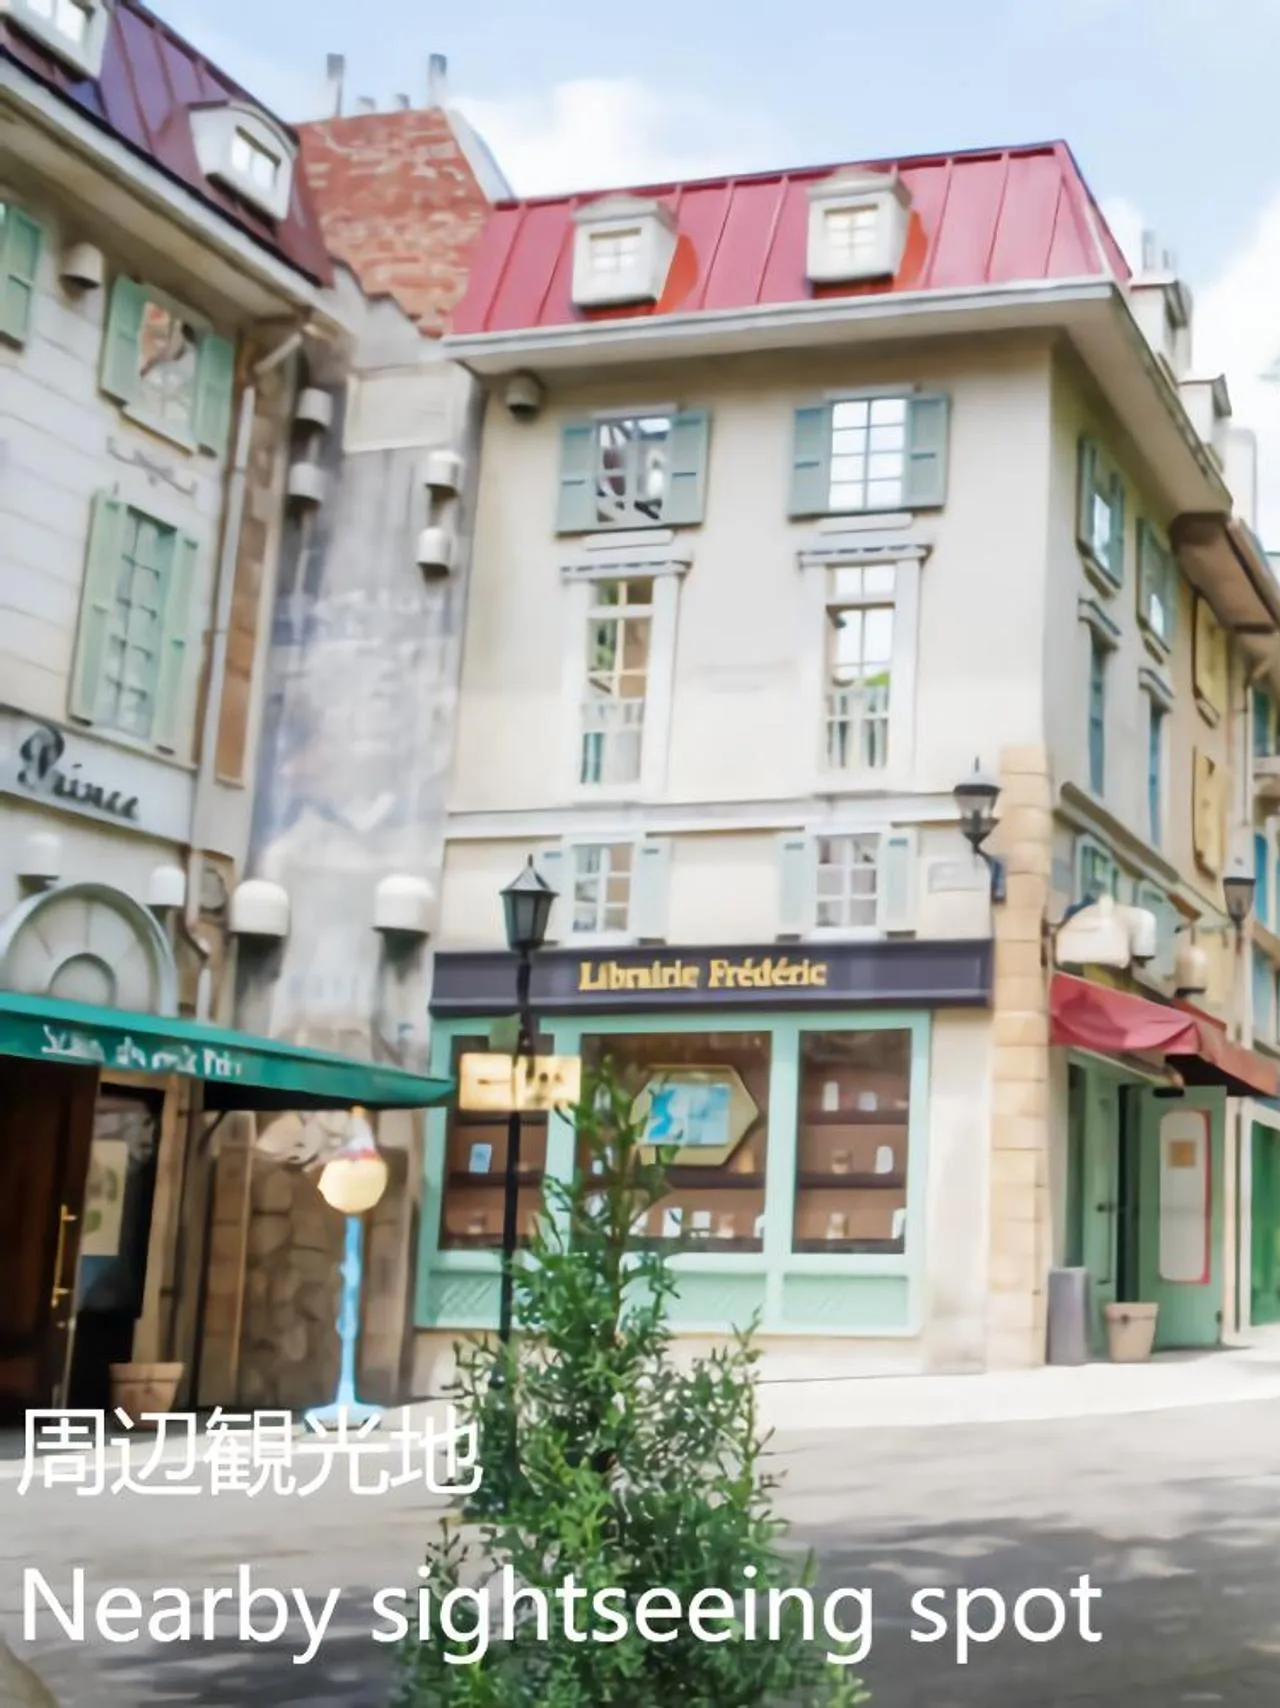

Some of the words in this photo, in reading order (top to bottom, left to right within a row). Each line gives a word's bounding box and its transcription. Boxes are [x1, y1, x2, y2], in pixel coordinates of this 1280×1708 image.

[17, 727, 139, 819] Prince
[579, 960, 699, 990] Librairie
[708, 957, 827, 987] Frédéric
